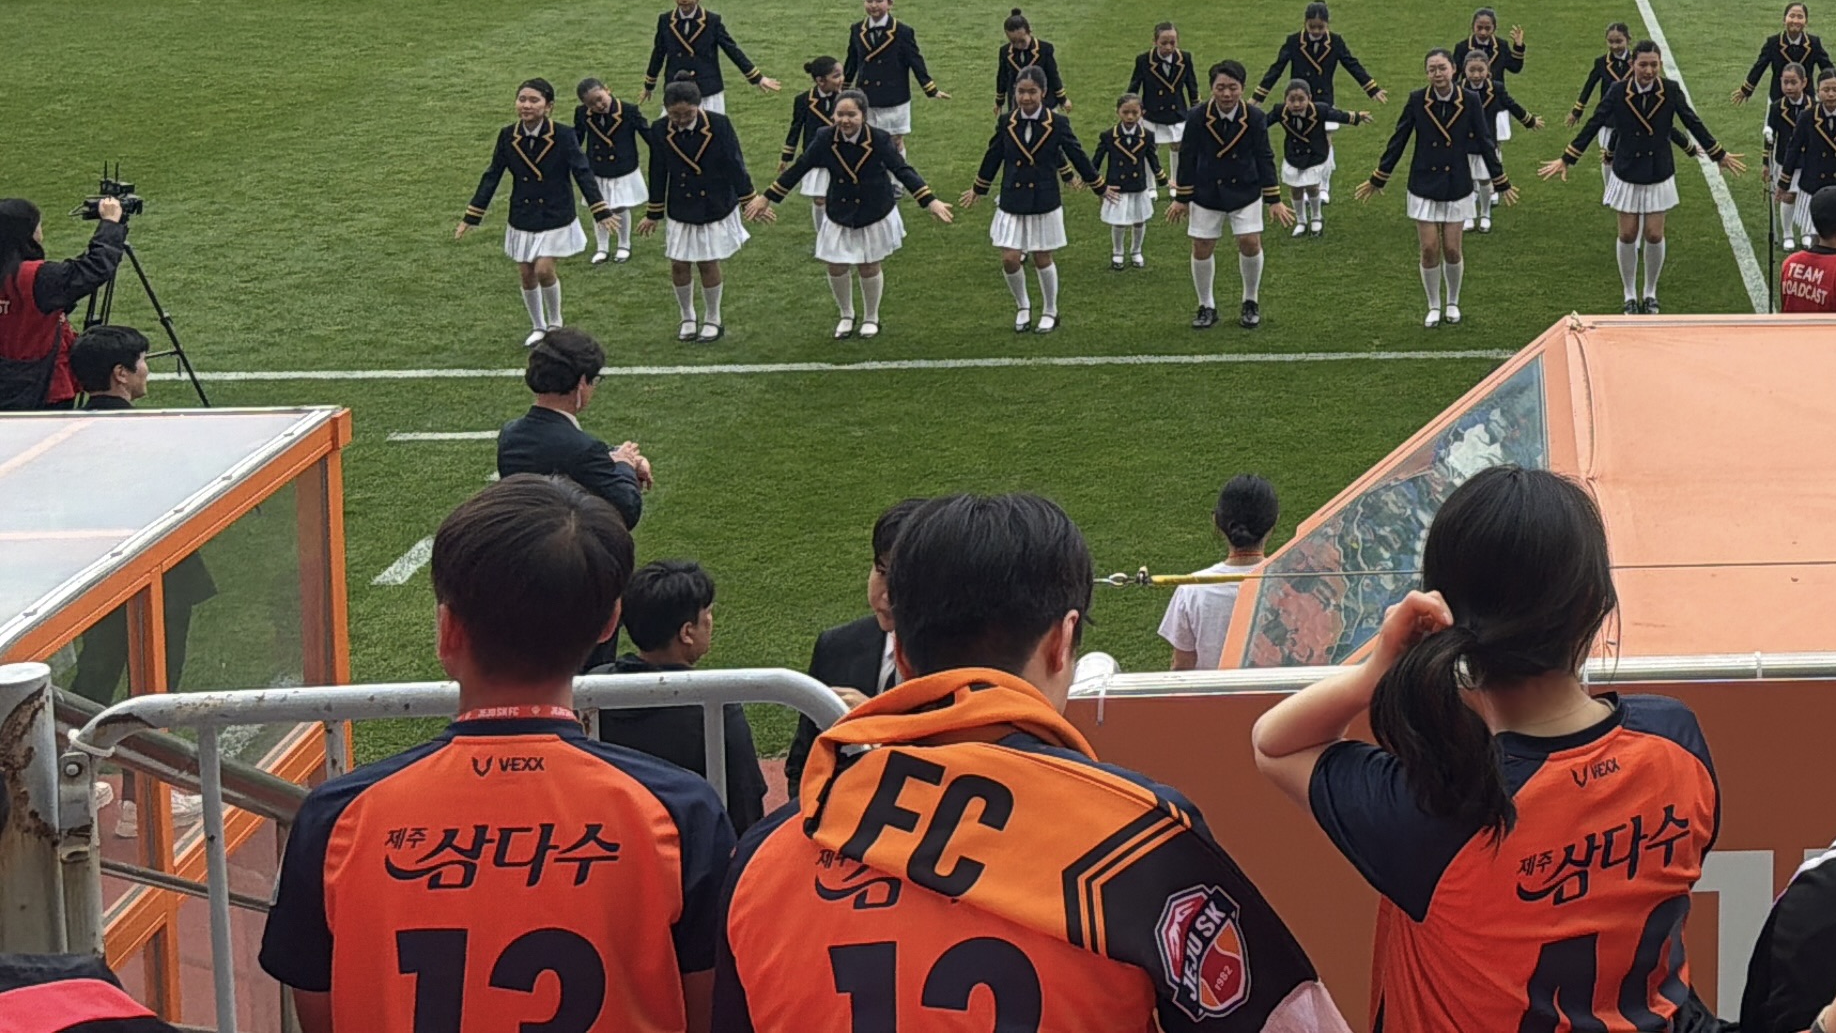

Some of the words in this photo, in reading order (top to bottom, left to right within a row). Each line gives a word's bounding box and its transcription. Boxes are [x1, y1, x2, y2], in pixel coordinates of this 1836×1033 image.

[1788, 262, 1825, 285] TEAM
[1781, 280, 1828, 306] OADCAST
[498, 757, 545, 772] VEXX
[840, 750, 1015, 897] FC
[384, 827, 428, 850] 제주
[385, 823, 620, 891] 삼다수
[1517, 804, 1690, 905] 삼다수
[1519, 851, 1553, 877] 제주
[1183, 932, 1203, 1001] JEJU
[1195, 901, 1226, 937] SK
[1215, 965, 1234, 991] 1982
